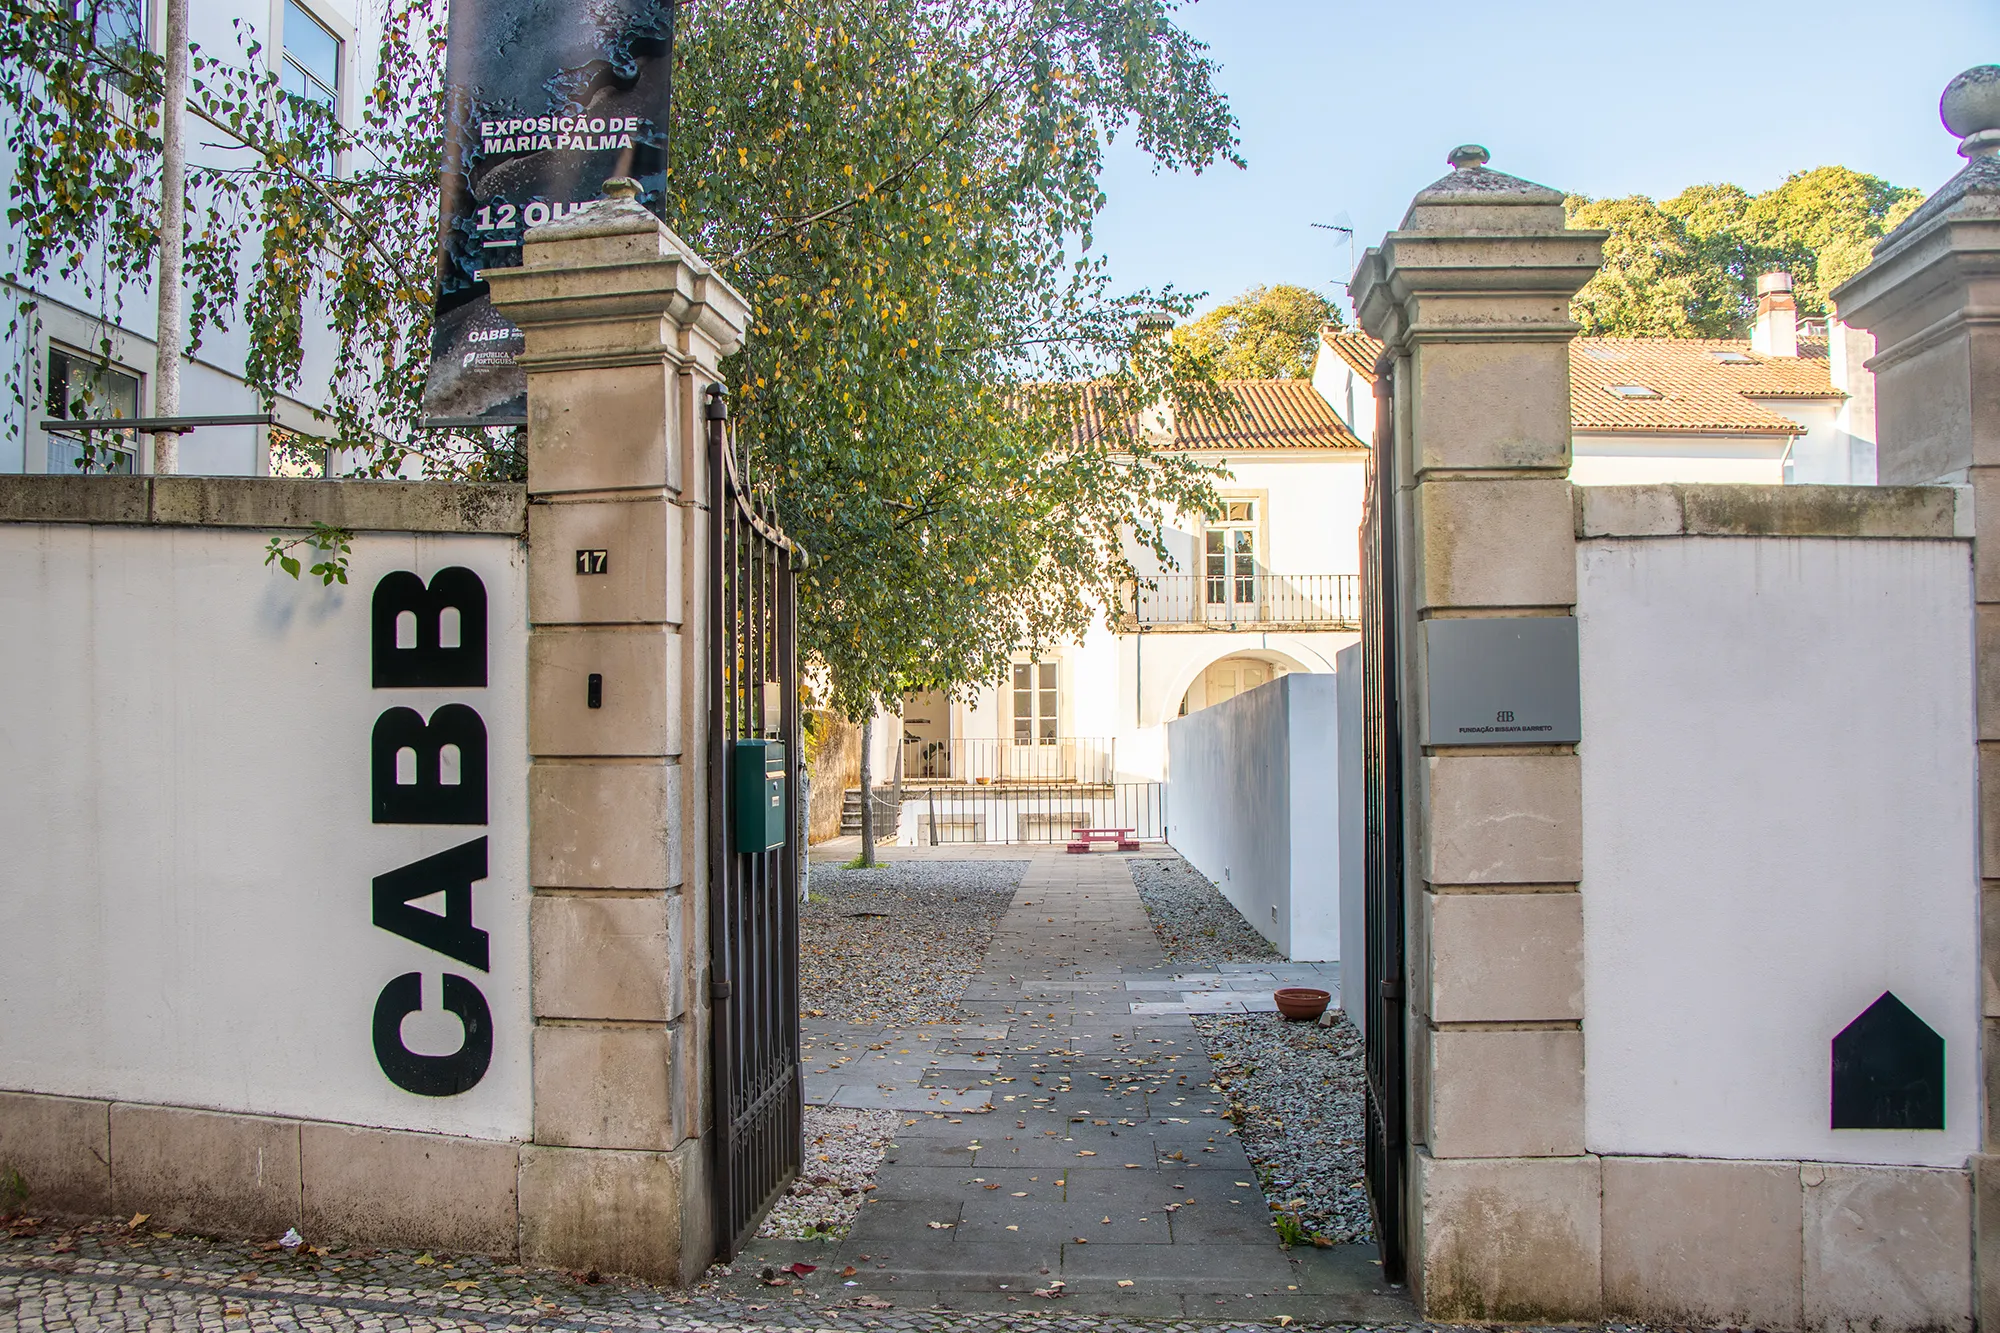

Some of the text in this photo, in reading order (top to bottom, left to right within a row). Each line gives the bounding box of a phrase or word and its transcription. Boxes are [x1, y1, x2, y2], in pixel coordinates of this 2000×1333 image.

[481, 114, 638, 136] EXPOSIÇÃO DE
[484, 133, 633, 154] MARIA PALMA
[476, 204, 516, 231] 12
[469, 328, 509, 342] CABB
[579, 551, 607, 572] 17
[372, 565, 494, 1097] CABB
